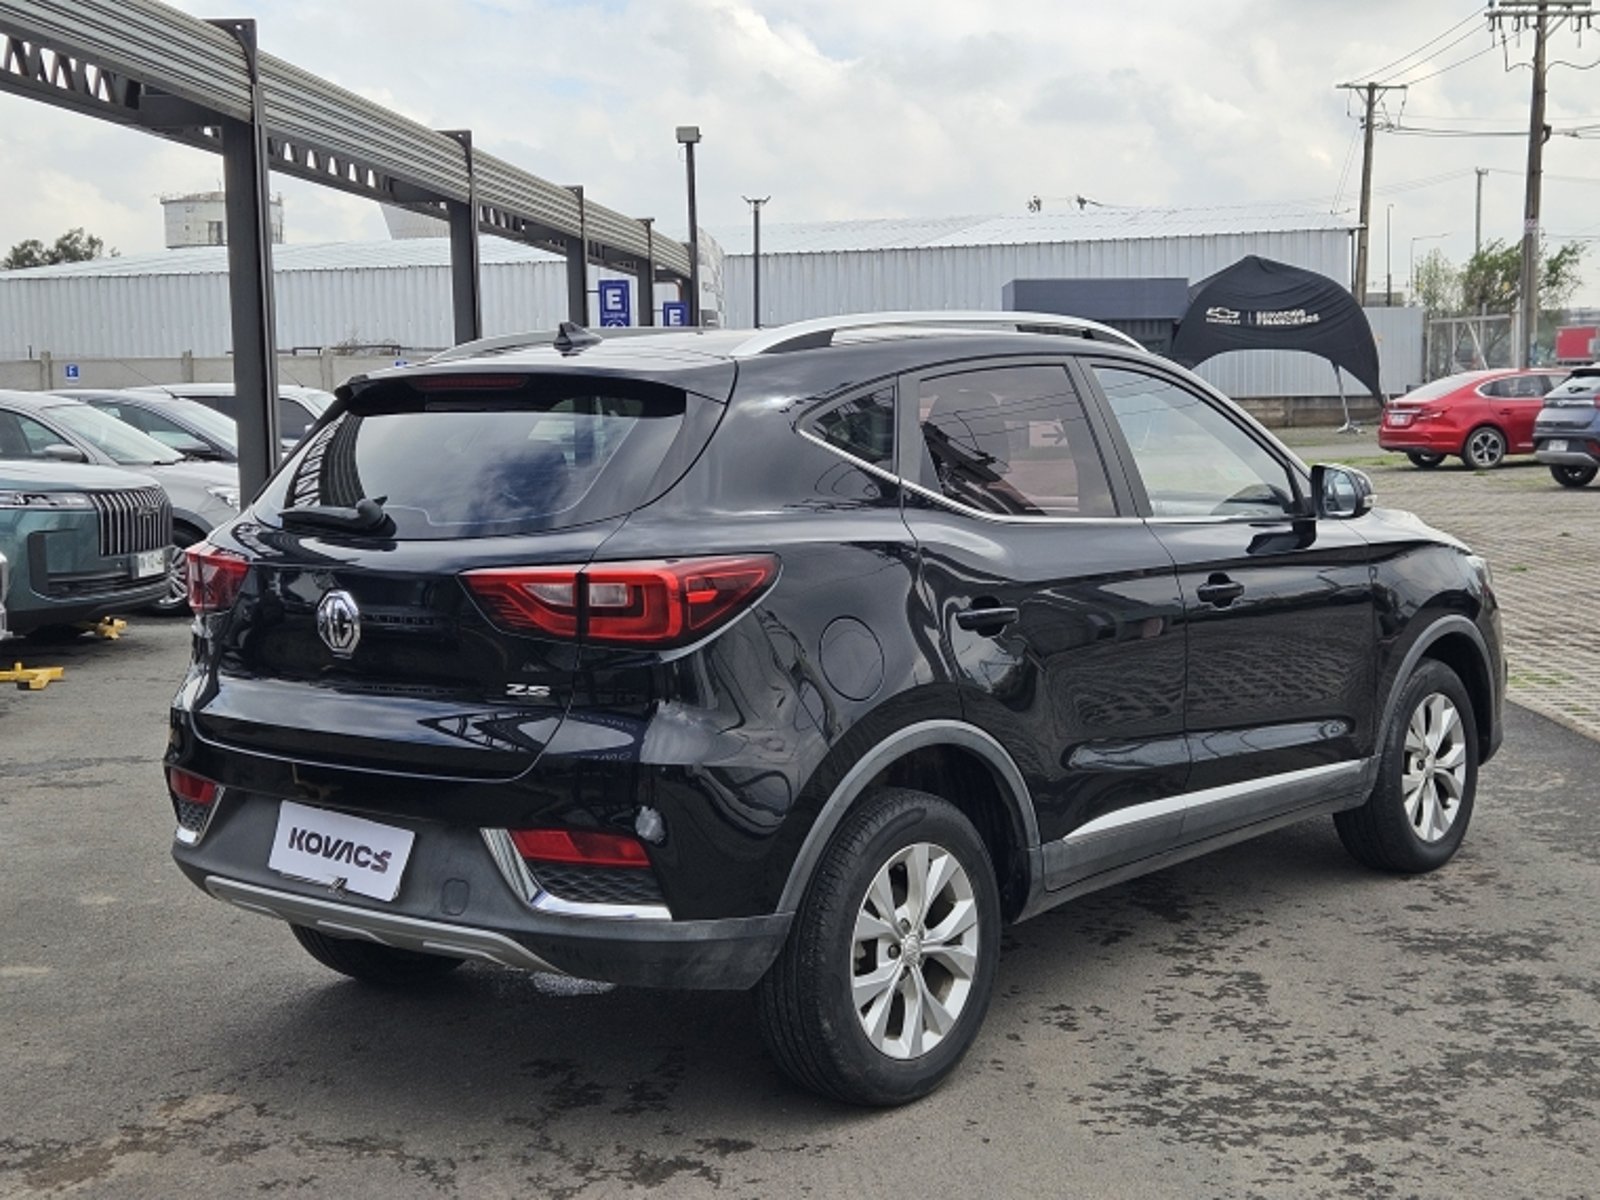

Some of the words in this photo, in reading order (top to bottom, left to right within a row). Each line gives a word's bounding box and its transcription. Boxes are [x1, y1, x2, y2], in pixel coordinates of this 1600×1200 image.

[605, 288, 621, 310] E
[668, 309, 681, 326] E
[506, 683, 550, 697] ZS
[288, 826, 392, 874] KOVACS
